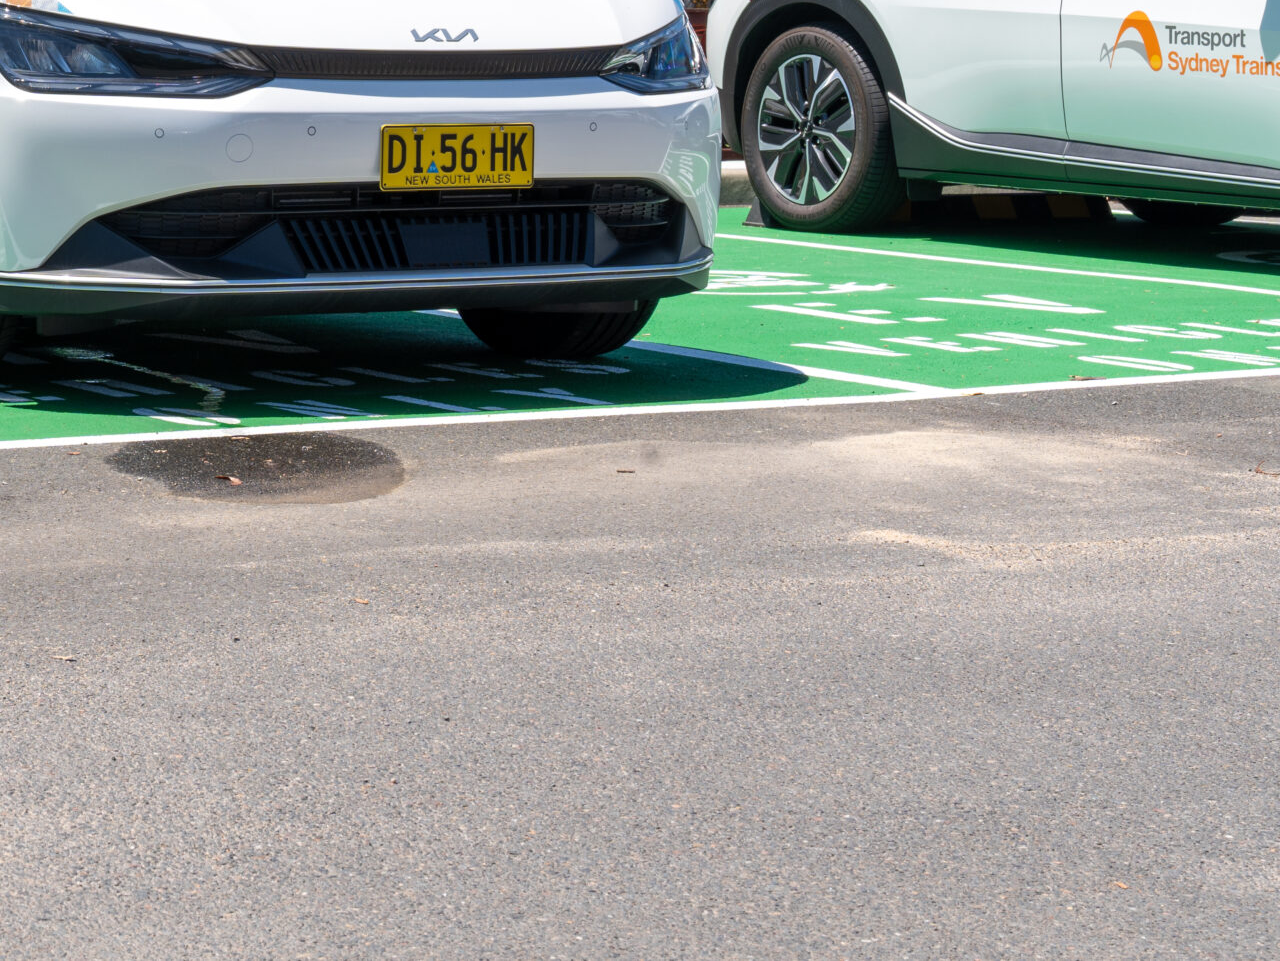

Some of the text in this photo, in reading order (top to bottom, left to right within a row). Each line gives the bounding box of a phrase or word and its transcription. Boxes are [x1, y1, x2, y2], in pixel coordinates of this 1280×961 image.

[410, 28, 479, 42] KIA
[1165, 25, 1246, 51] Transport
[1167, 51, 1229, 78] Sydney
[405, 174, 511, 186] NEW SOUTH WALES
[790, 318, 1280, 357] VEHICL
